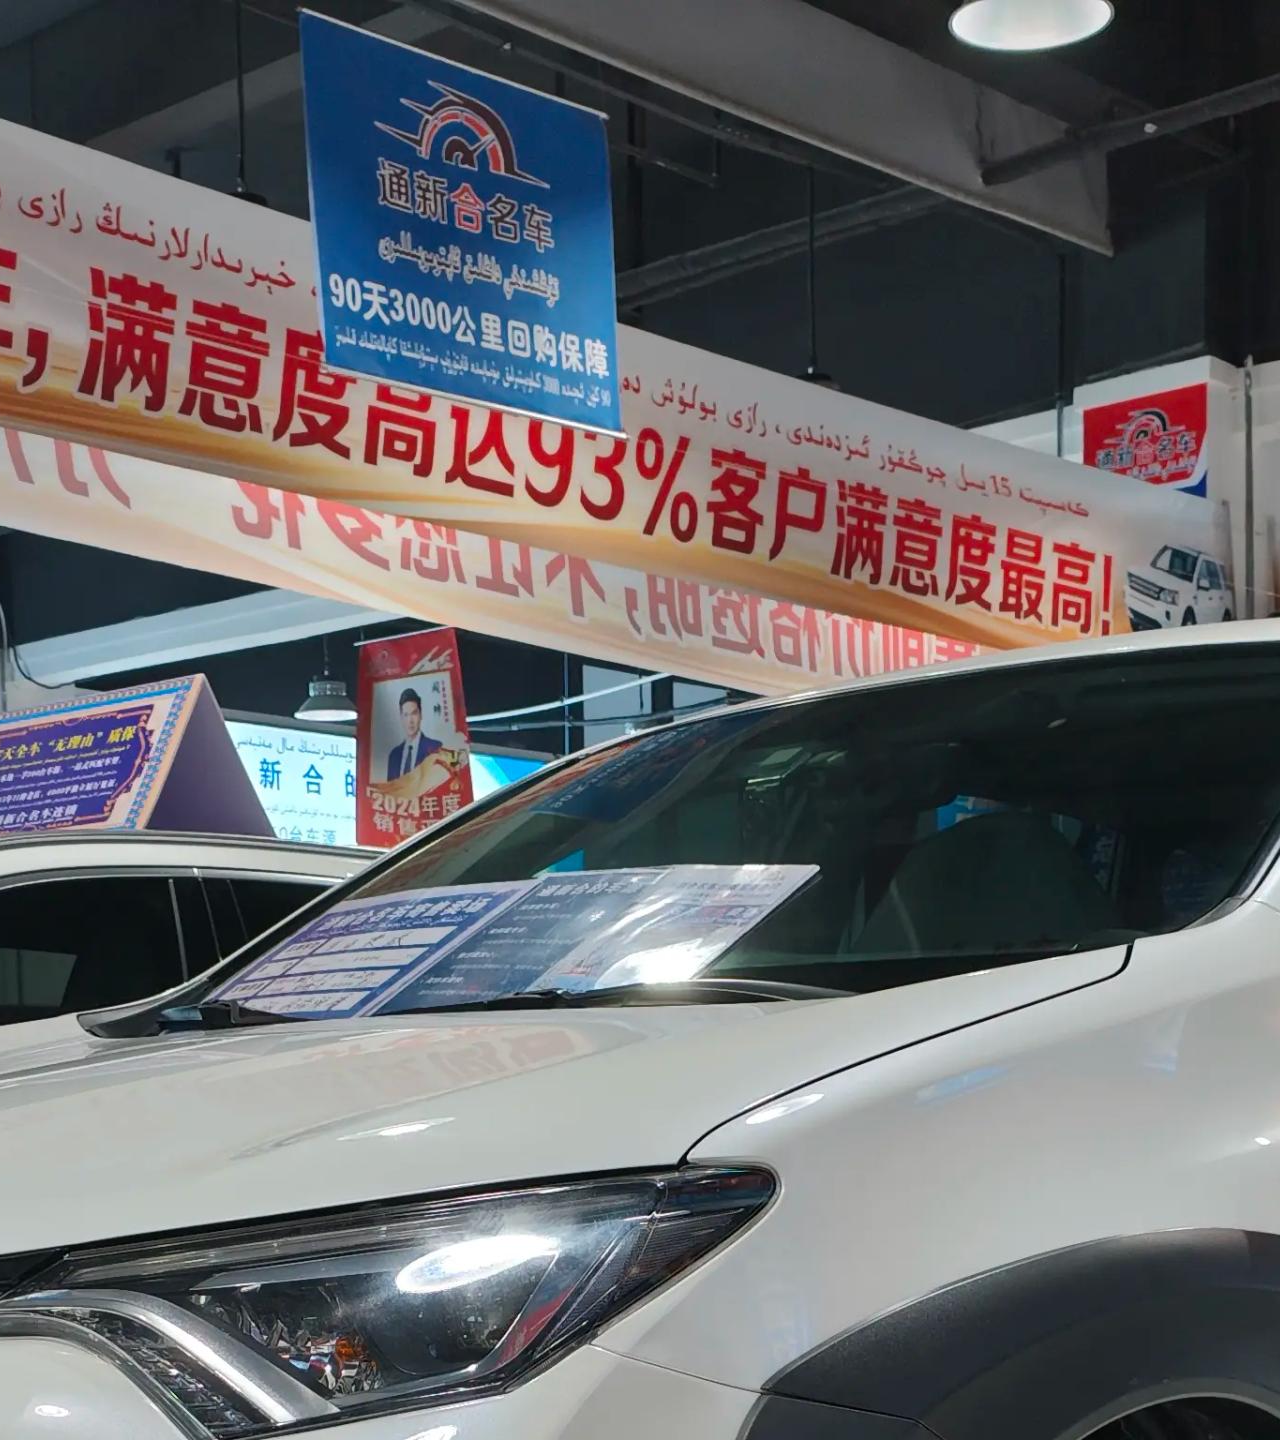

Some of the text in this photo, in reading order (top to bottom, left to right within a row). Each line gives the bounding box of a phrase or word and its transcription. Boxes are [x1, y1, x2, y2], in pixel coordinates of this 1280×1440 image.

[376, 156, 556, 253] 通新合名车
[328, 272, 610, 379] 90天3000公里回购保障
